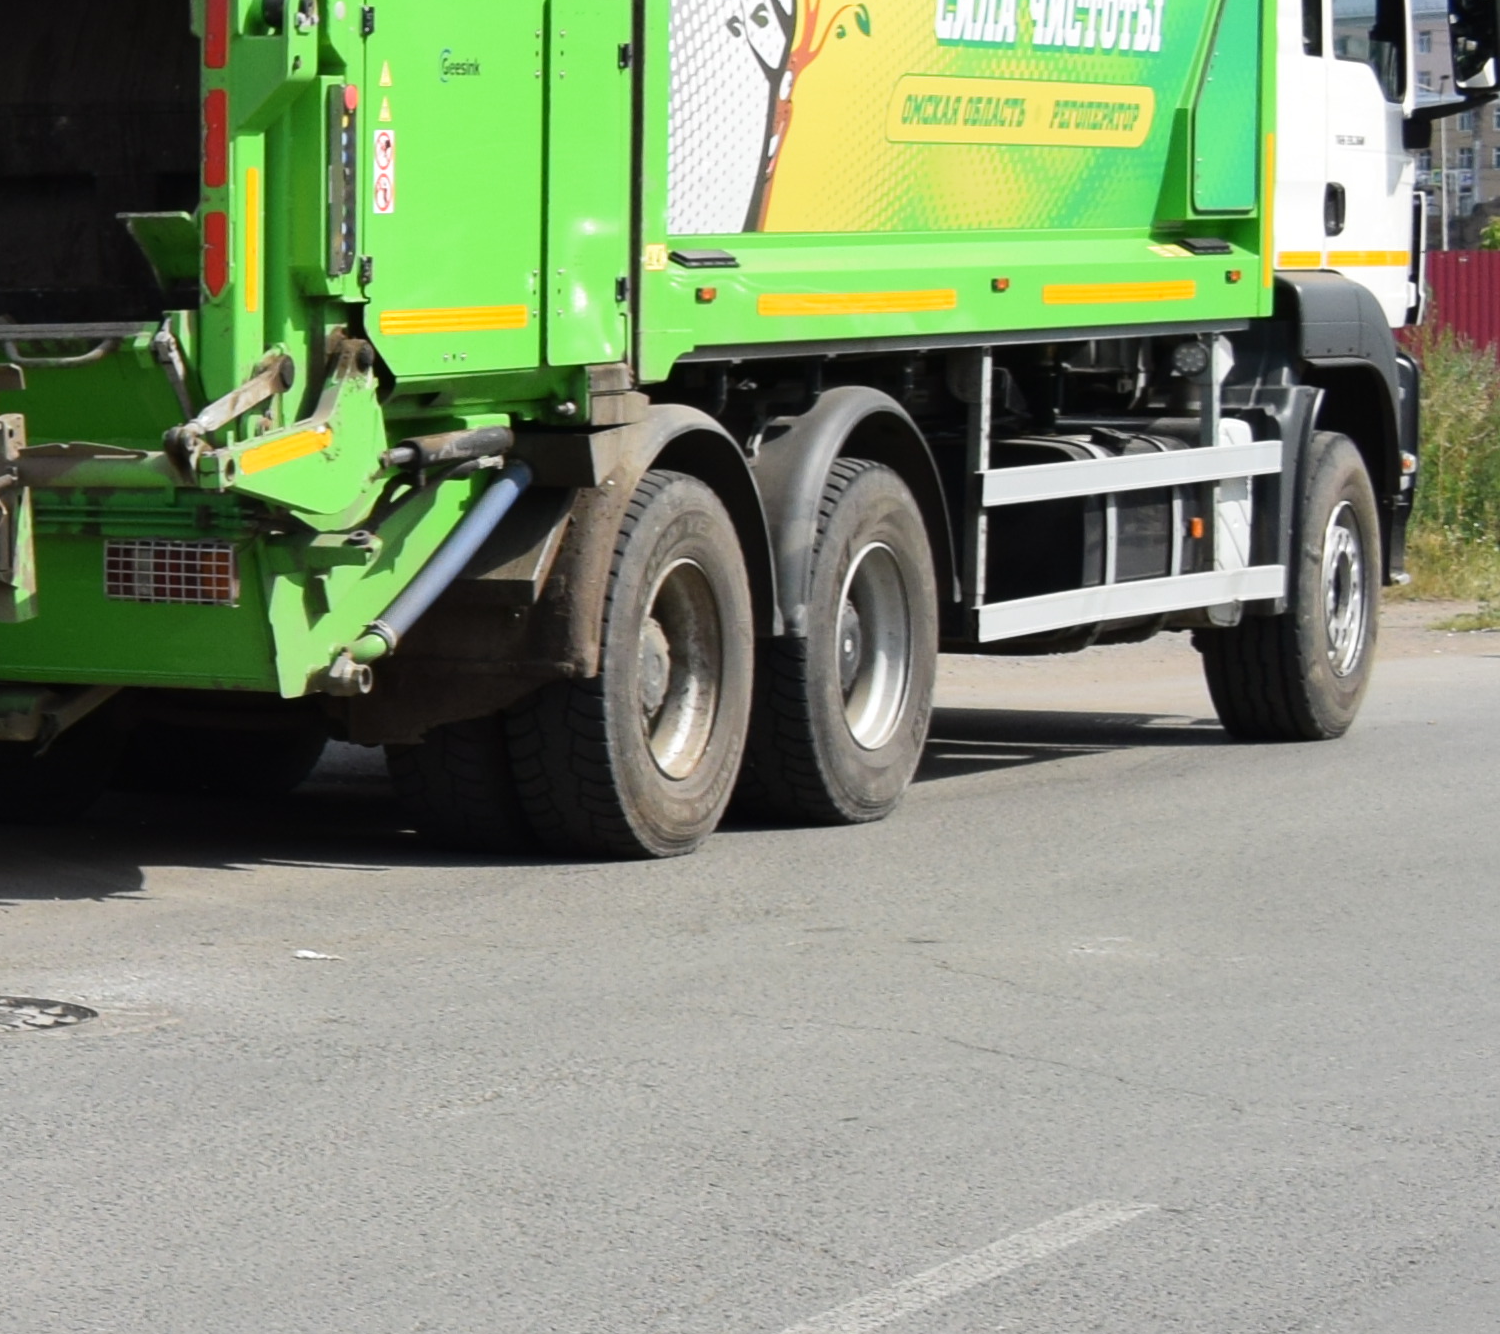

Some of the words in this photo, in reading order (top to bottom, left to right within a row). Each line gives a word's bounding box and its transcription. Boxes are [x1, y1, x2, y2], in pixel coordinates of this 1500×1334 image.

[441, 56, 481, 76] Geesink
[901, 94, 962, 126] ОМСКАЯ
[963, 95, 1026, 128] ОБЛАСТЬ
[1049, 99, 1141, 132] РЕГОПЕРАТОР
